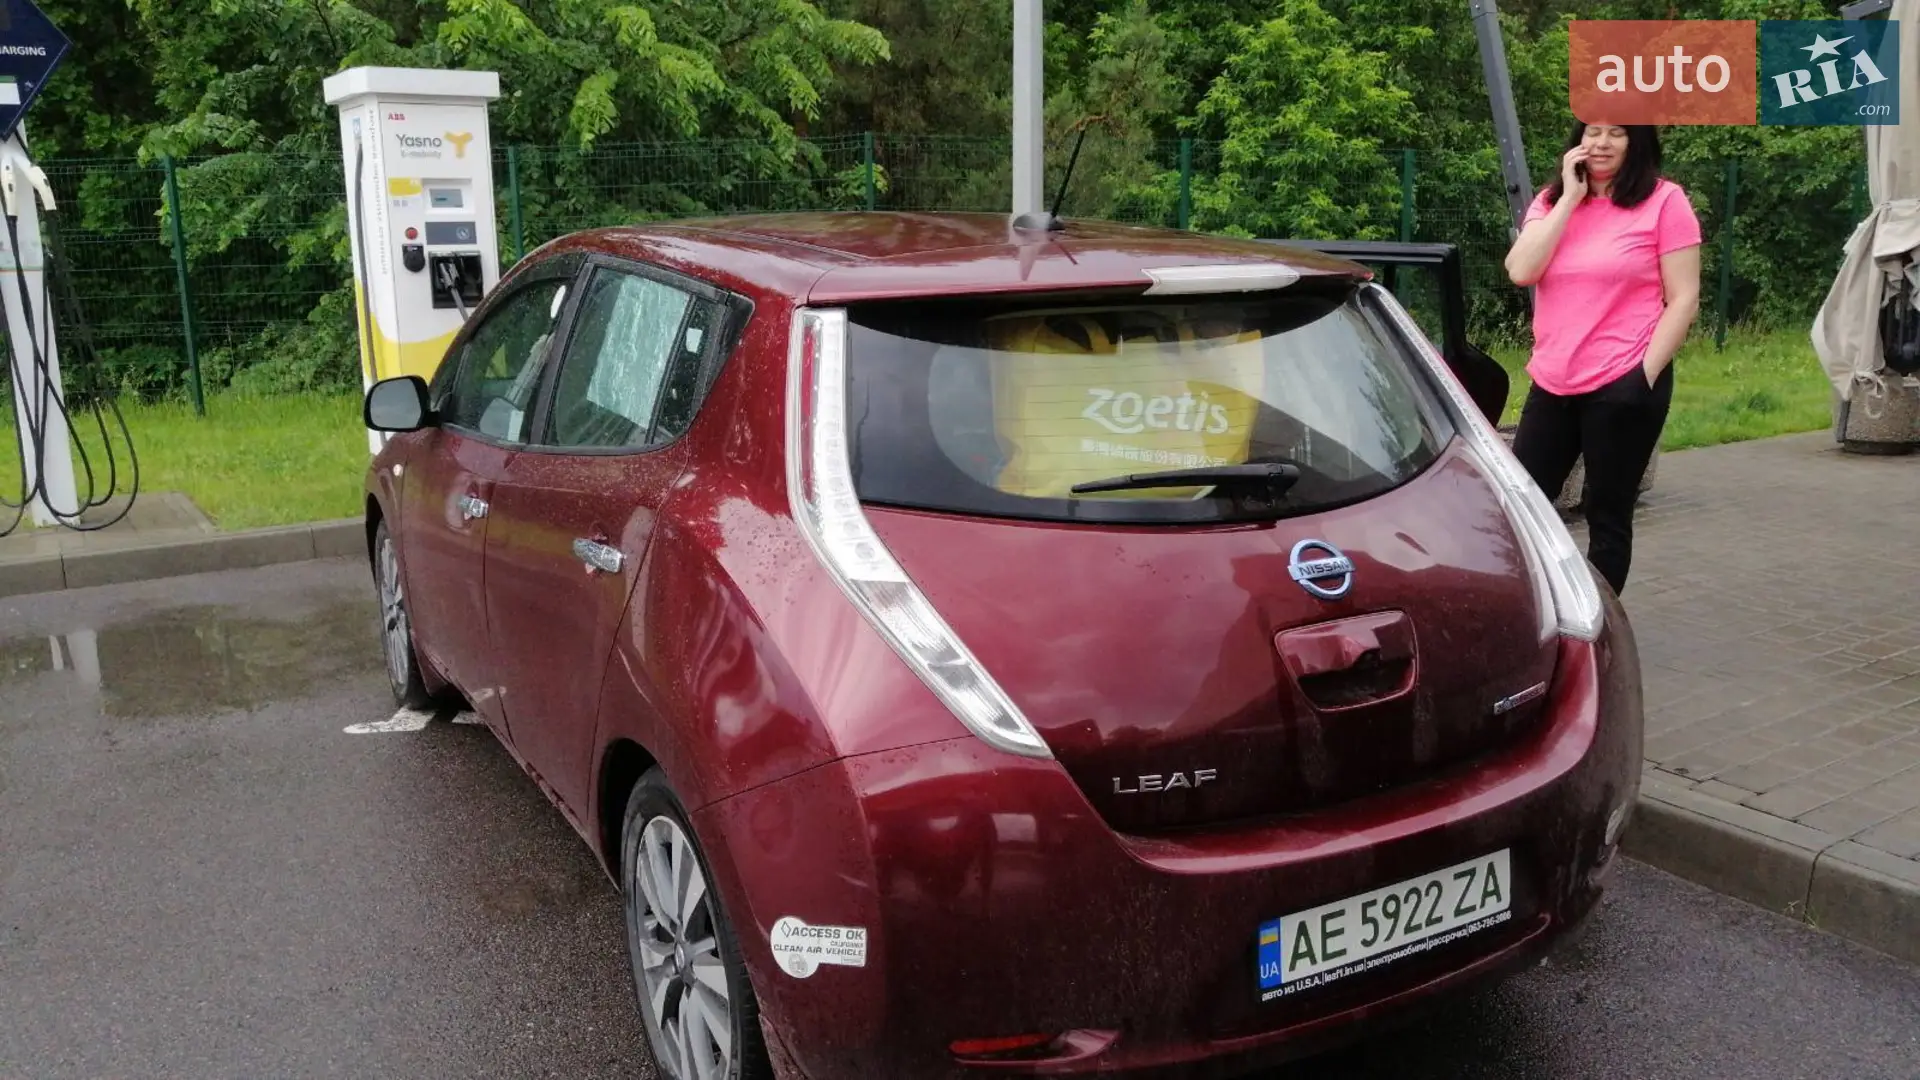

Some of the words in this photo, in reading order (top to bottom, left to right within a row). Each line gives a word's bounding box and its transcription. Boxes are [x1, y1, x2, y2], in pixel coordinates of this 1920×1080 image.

[0, 46, 46, 56] ARGING
[396, 133, 442, 148] Yasno
[1082, 388, 1229, 434] zoetis
[1298, 560, 1350, 576] NISSAN
[1112, 768, 1217, 794] LEAF
[1288, 909, 1347, 973] AE
[1360, 880, 1443, 948] 5922
[1453, 861, 1502, 918] ZA
[791, 927, 841, 939] ACCESS
[846, 930, 864, 940] OK
[774, 944, 804, 953] CLEAN
[806, 946, 822, 954] AIR
[826, 947, 864, 957] VEHICLE
[1260, 961, 1280, 979] UA
